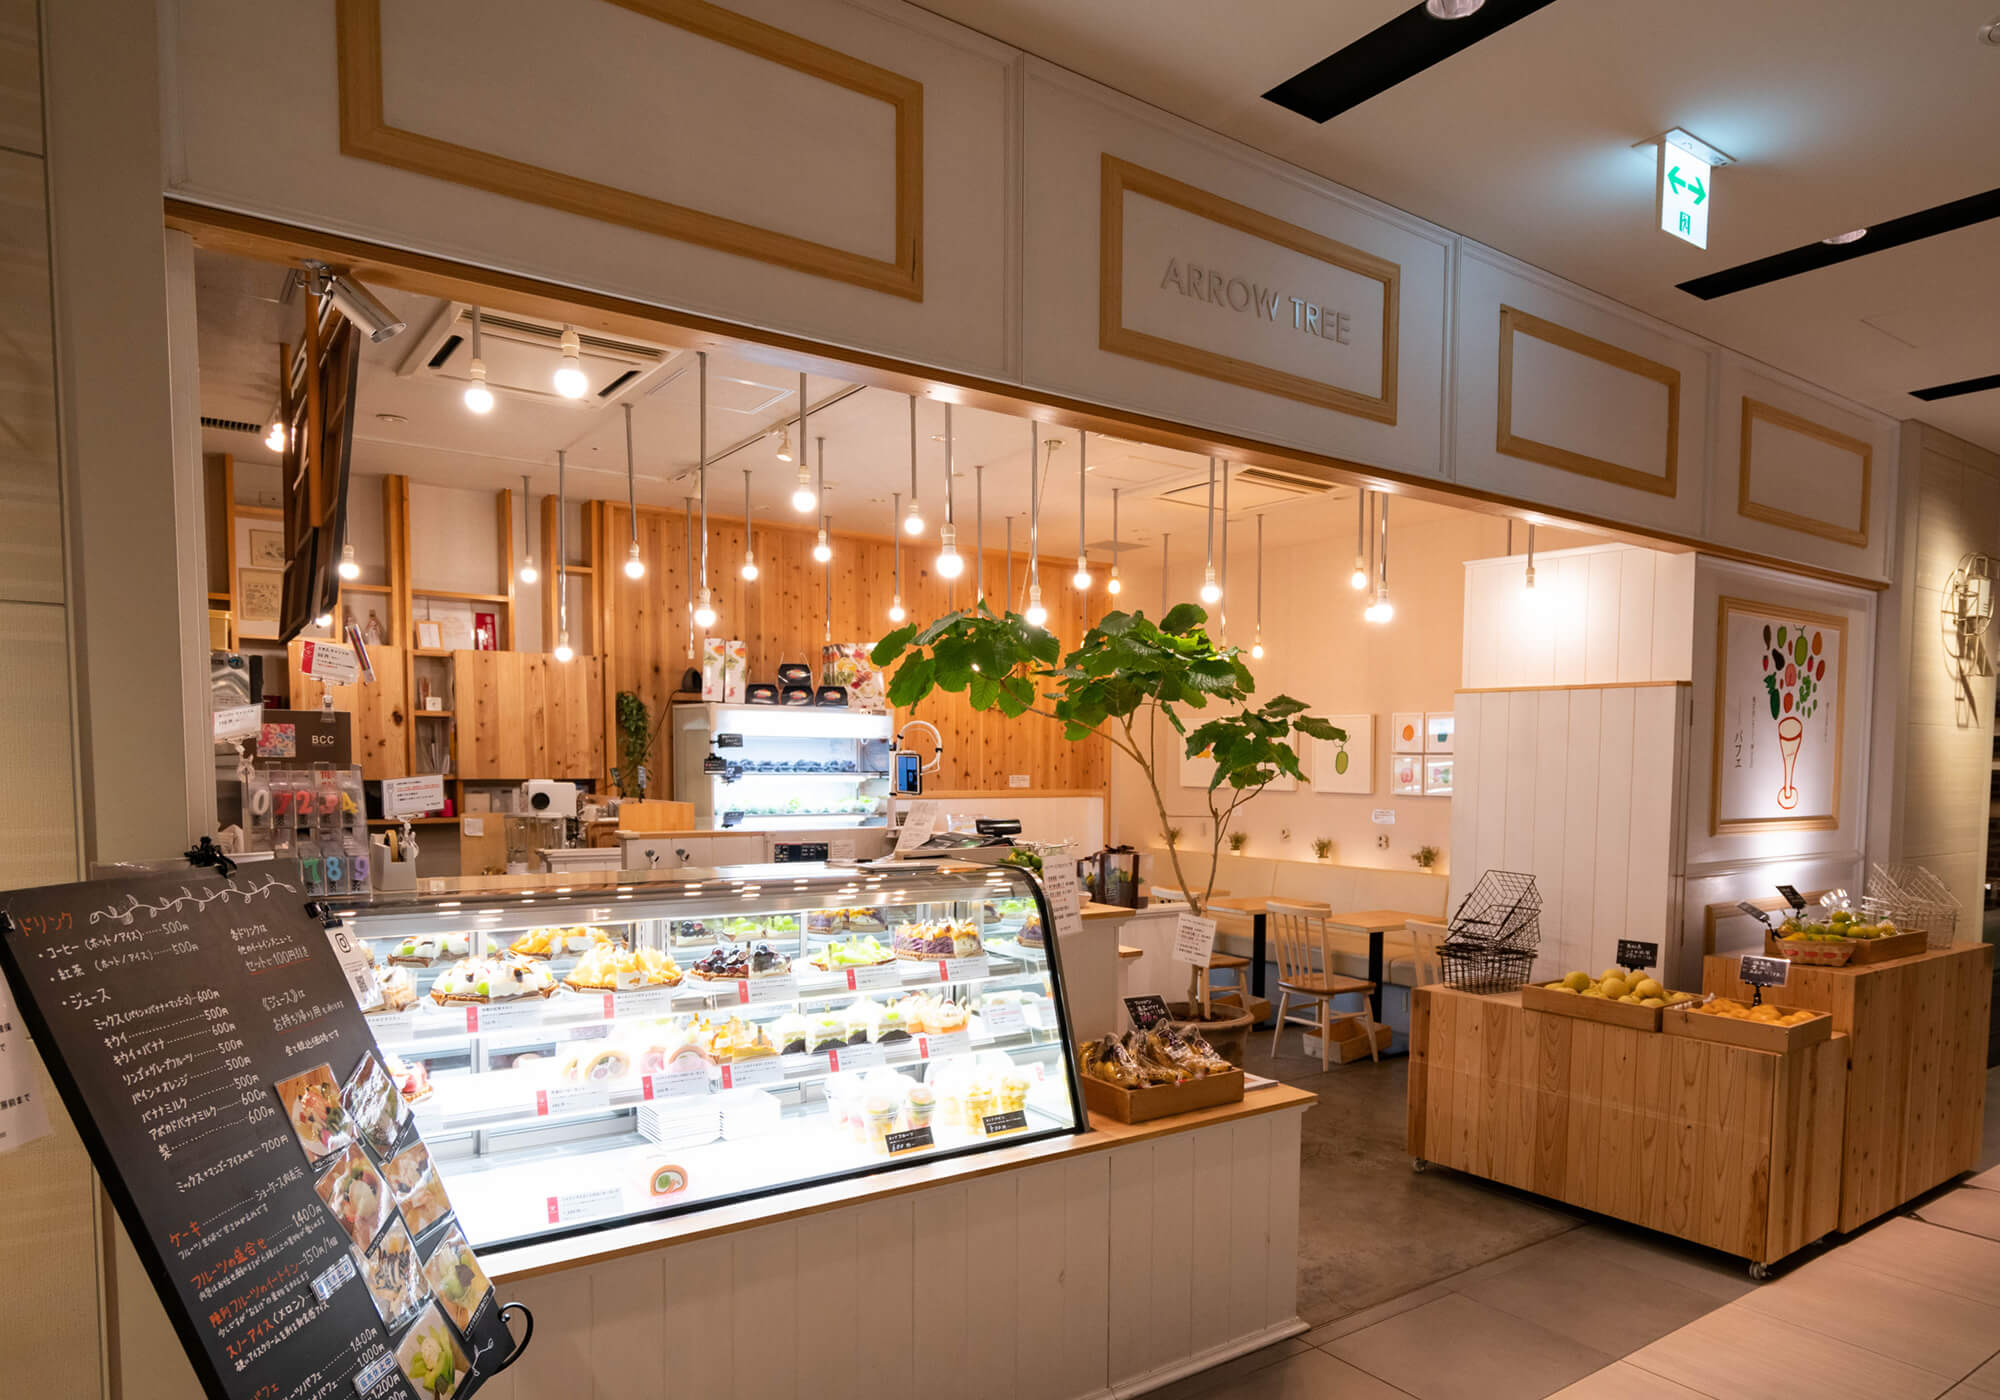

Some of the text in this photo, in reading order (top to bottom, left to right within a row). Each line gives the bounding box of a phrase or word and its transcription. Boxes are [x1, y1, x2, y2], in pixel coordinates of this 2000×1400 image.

[1160, 256, 1350, 346] ARROW TREE
[311, 735, 334, 745] BCC
[19, 911, 74, 937] ドリンク
[46, 944, 80, 960] コーヒー
[161, 921, 189, 935] 500円
[57, 964, 86, 982] 紅茶
[172, 941, 200, 955] 500円
[69, 988, 112, 1011] ジュース
[196, 989, 221, 1003] 600円
[103, 1006, 230, 1049] キウイ 500円
[211, 1022, 237, 1037] 600円
[217, 1039, 244, 1054] 500円
[224, 1056, 251, 1072] 500円
[142, 1073, 260, 1123] バナナミルク 500円
[148, 1088, 268, 1141] アボカドバナナミルク 600円
[247, 1105, 276, 1125] 600円
[260, 1134, 289, 1153] 700円
[168, 1220, 201, 1248] ケーキ
[189, 1203, 322, 1290] フルーツの盛合せ 1,400円
[350, 1327, 378, 1352] 1,400円
[356, 1342, 385, 1367] 1,000円
